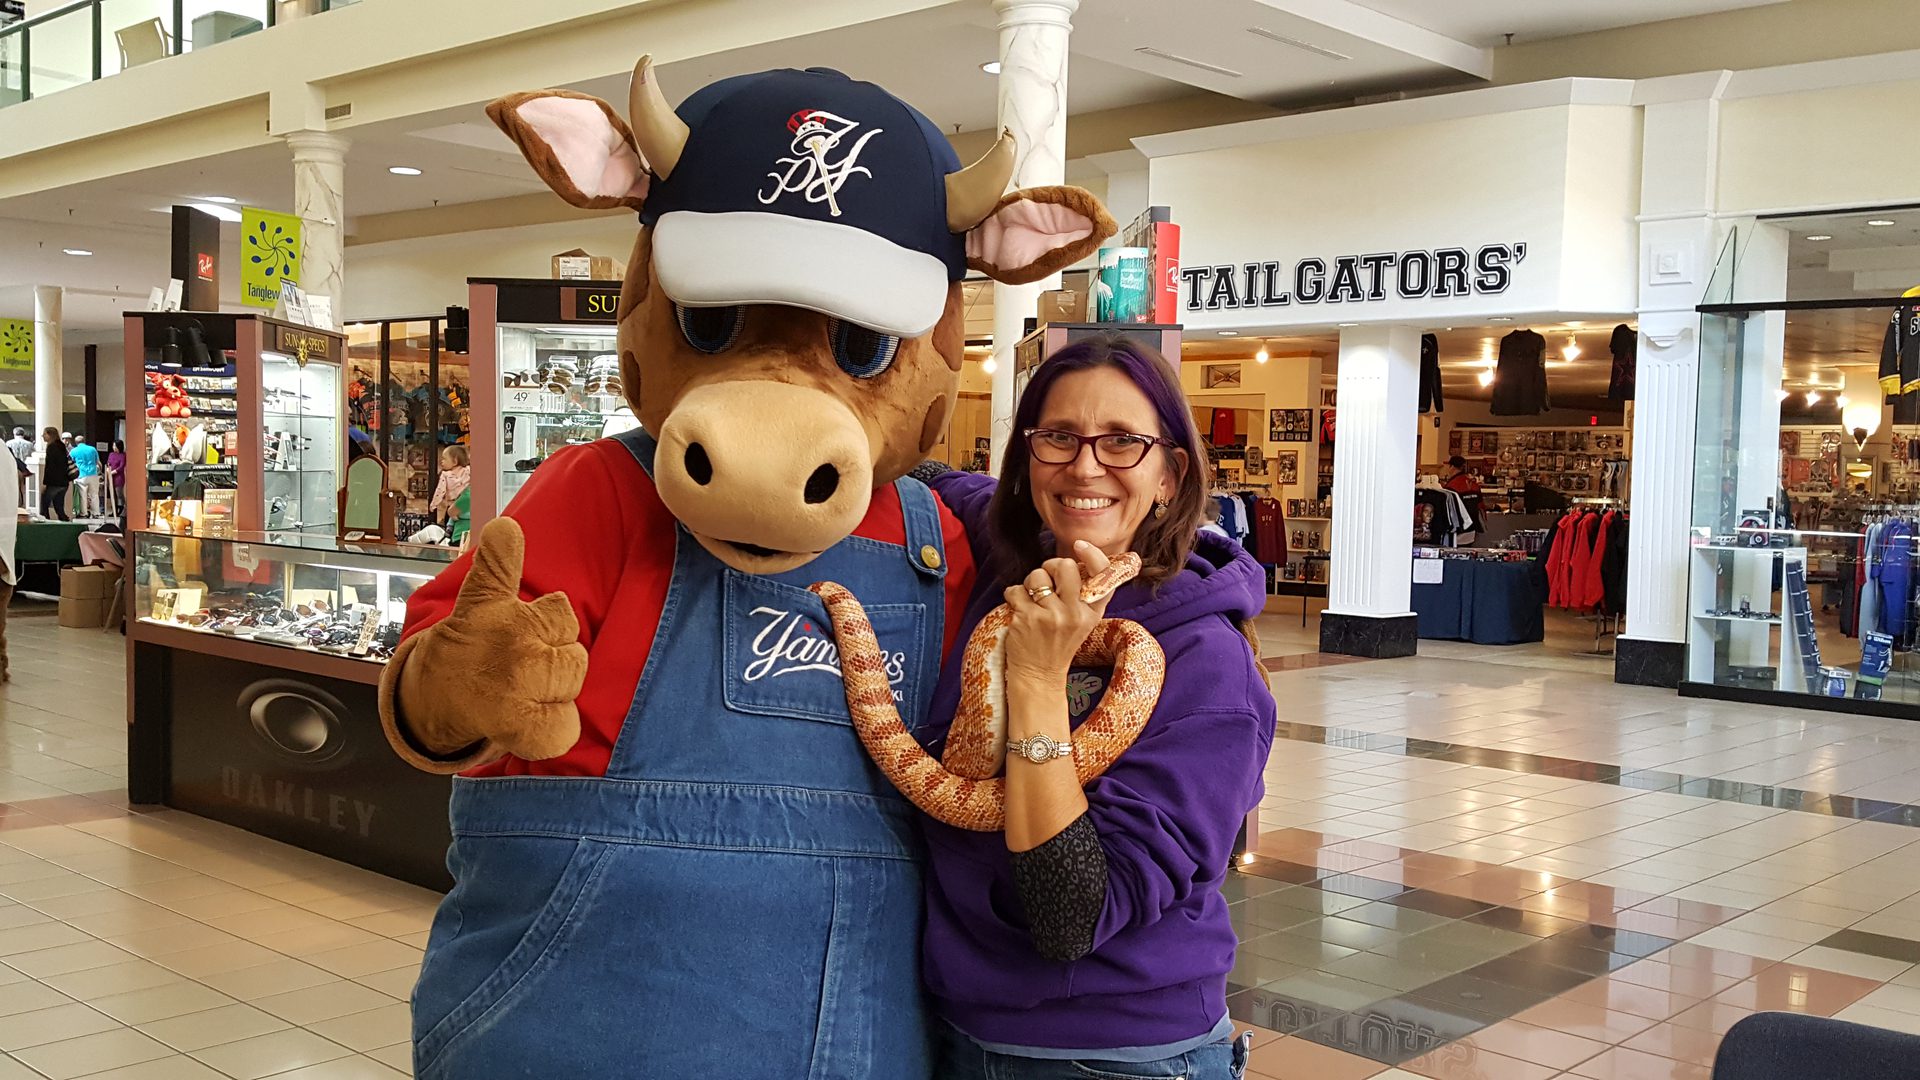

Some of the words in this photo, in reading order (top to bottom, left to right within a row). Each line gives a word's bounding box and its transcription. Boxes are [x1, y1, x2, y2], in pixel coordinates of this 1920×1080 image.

[1180, 242, 1527, 311] TAILGATORS'
[285, 332, 298, 347] SUN
[308, 339, 325, 352] SPECS
[221, 765, 377, 837] OAKLEY
